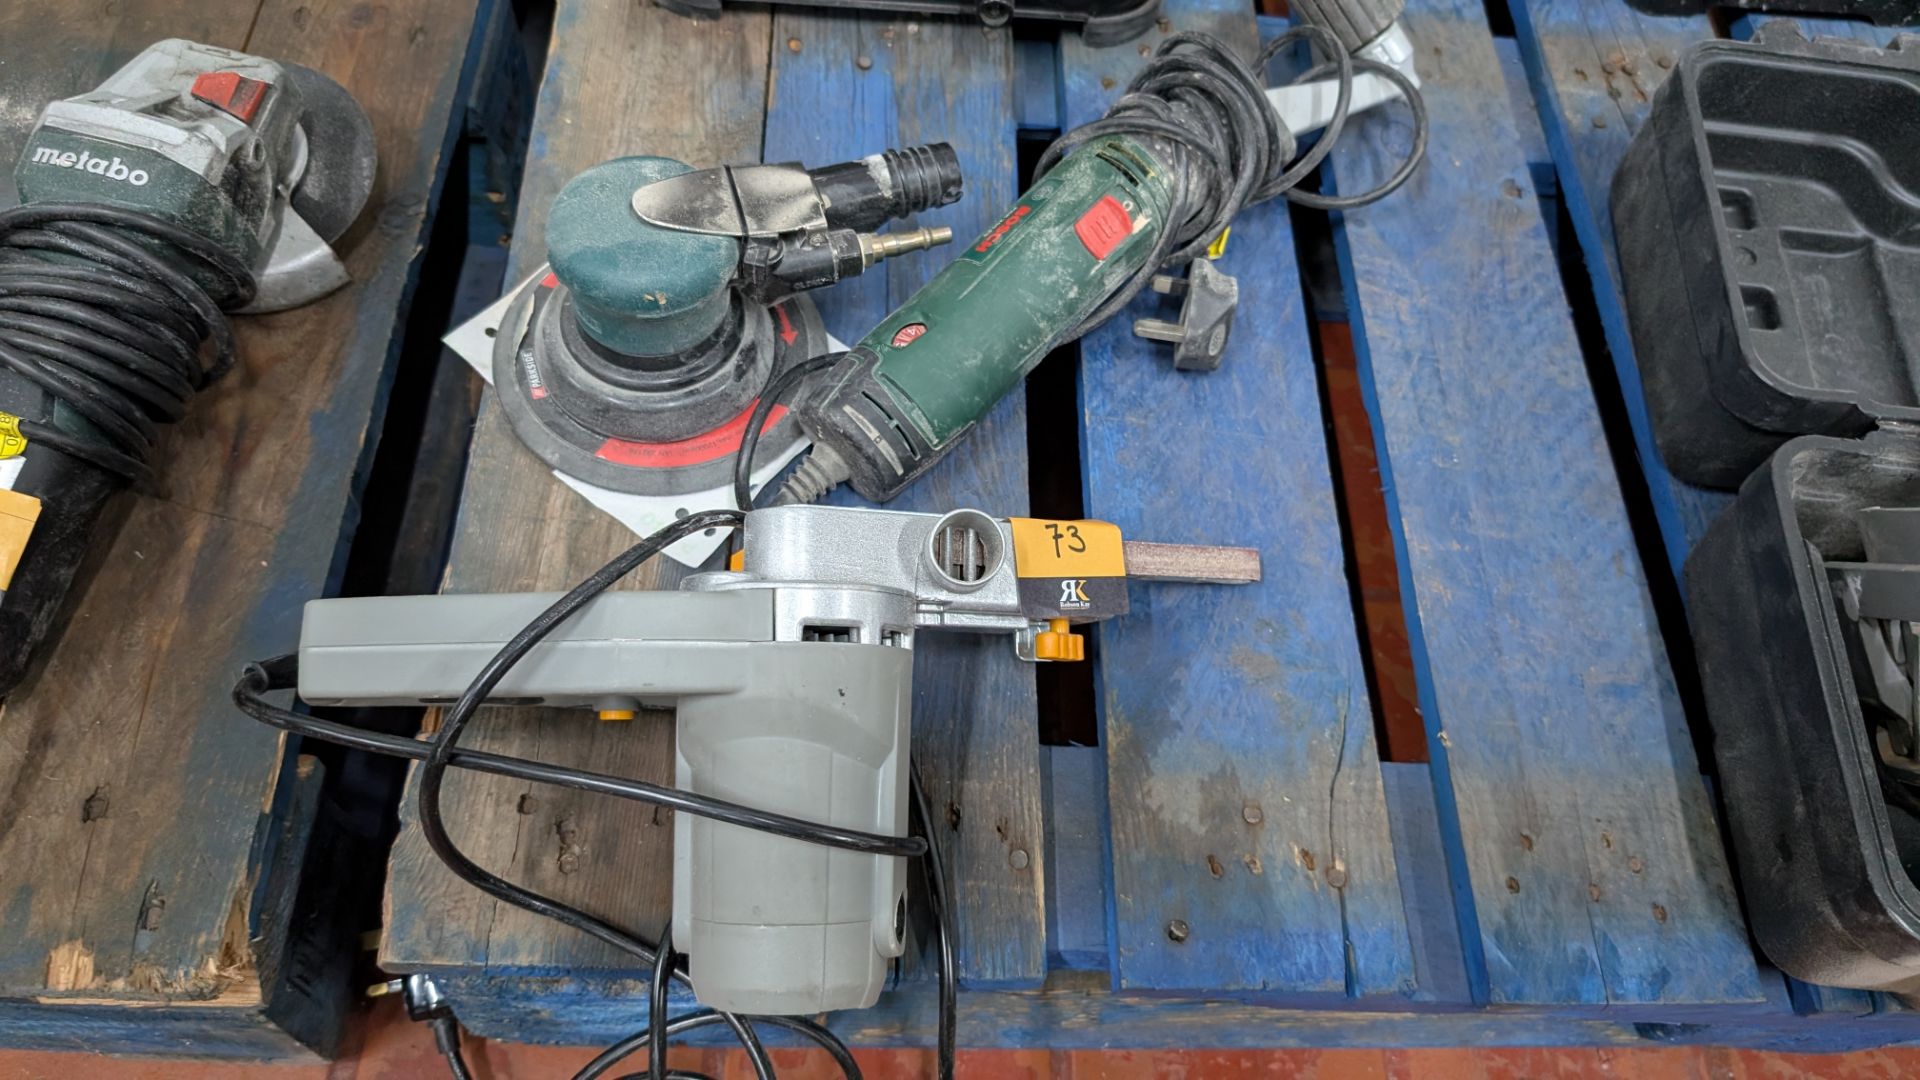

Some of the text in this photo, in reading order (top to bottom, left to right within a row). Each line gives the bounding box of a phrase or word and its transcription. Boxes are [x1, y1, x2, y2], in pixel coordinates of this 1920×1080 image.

[32, 147, 149, 186] metabo
[975, 205, 1031, 252] BOSCH
[523, 352, 542, 388] PARKSIDE
[1045, 523, 1086, 558] 73
